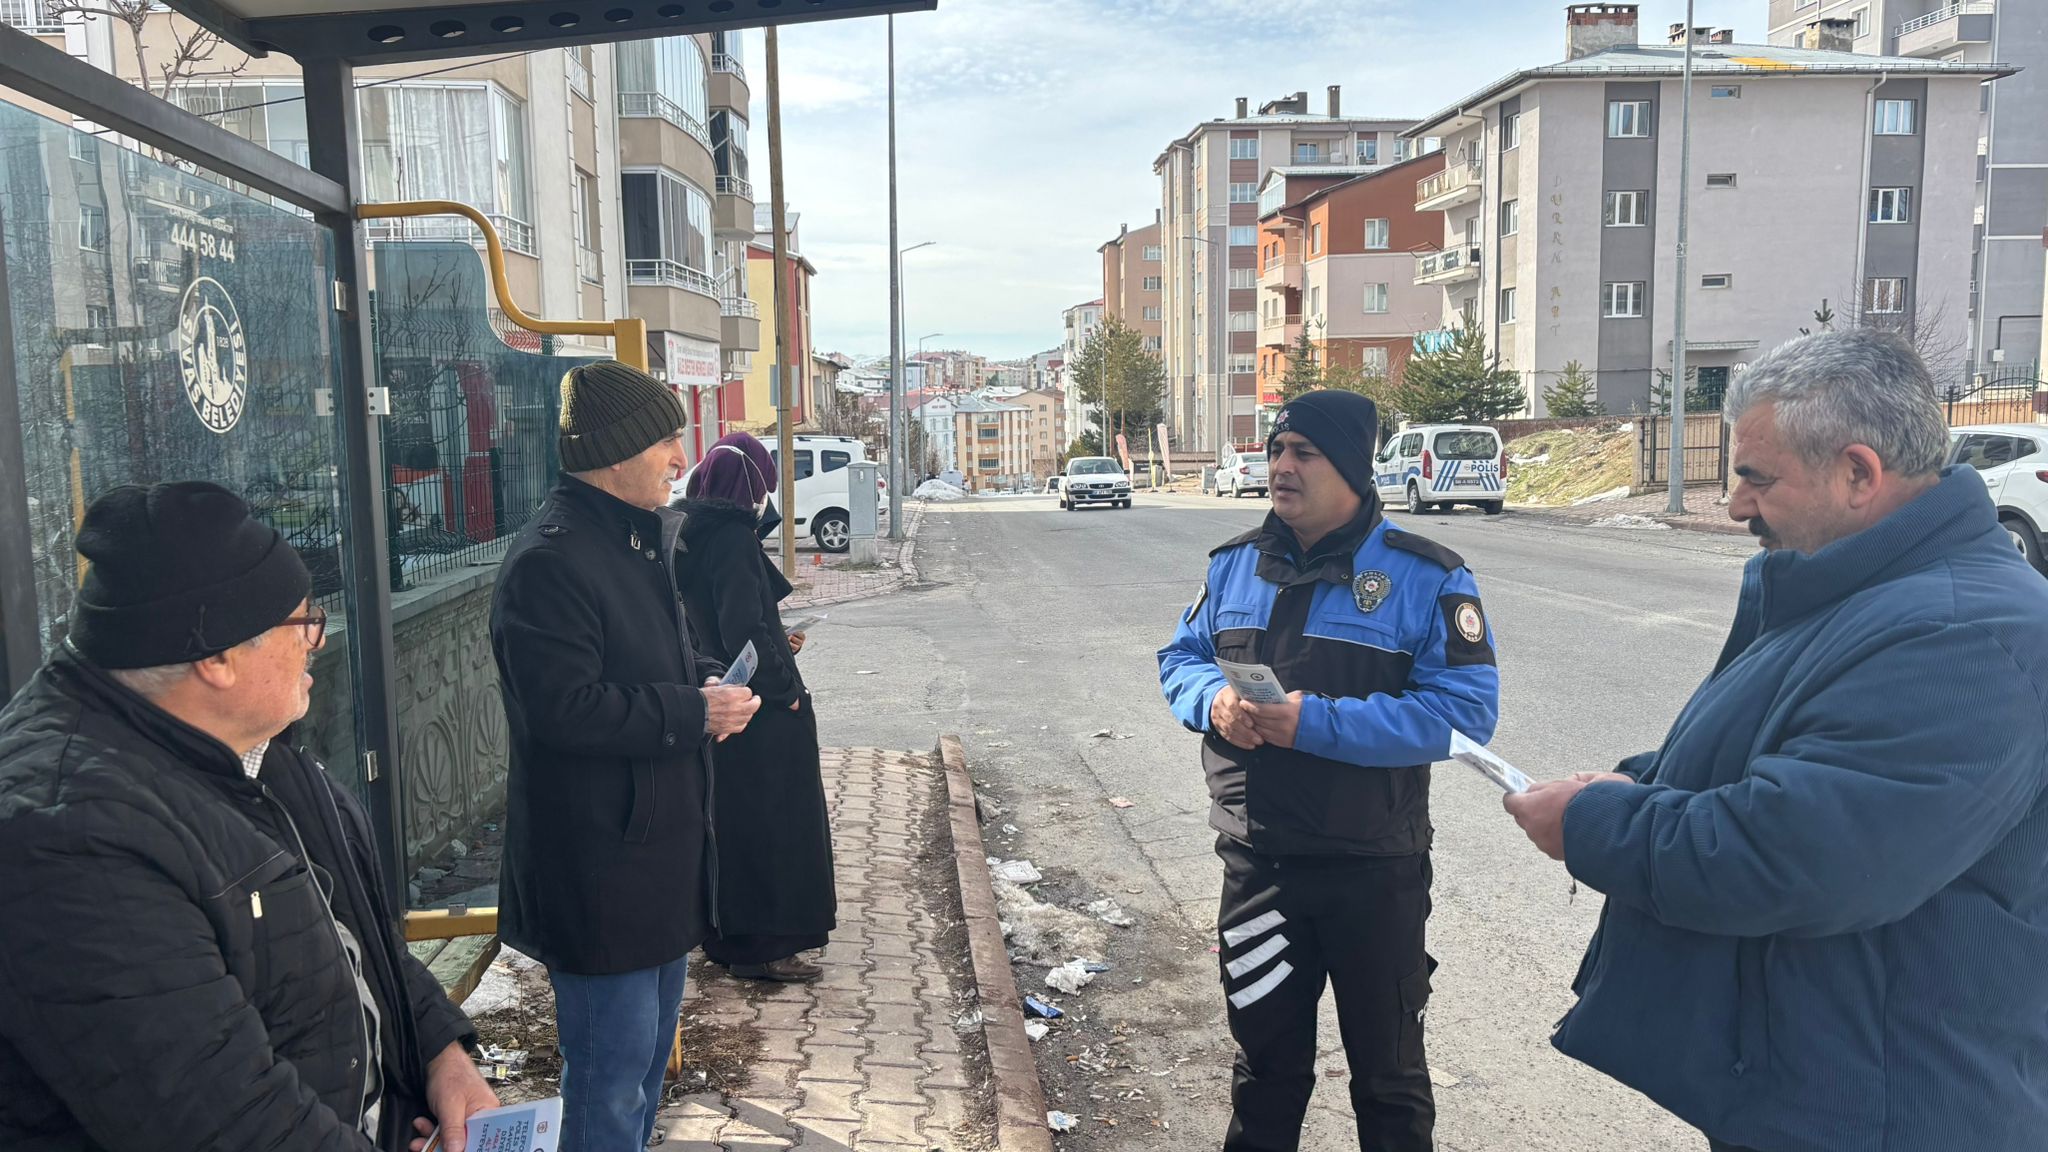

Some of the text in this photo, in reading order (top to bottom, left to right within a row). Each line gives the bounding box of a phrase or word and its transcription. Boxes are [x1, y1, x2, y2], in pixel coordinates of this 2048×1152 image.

[171, 222, 235, 263] 444 58 44
[181, 313, 202, 404] SIVAS
[1470, 462, 1499, 473] POLİS
